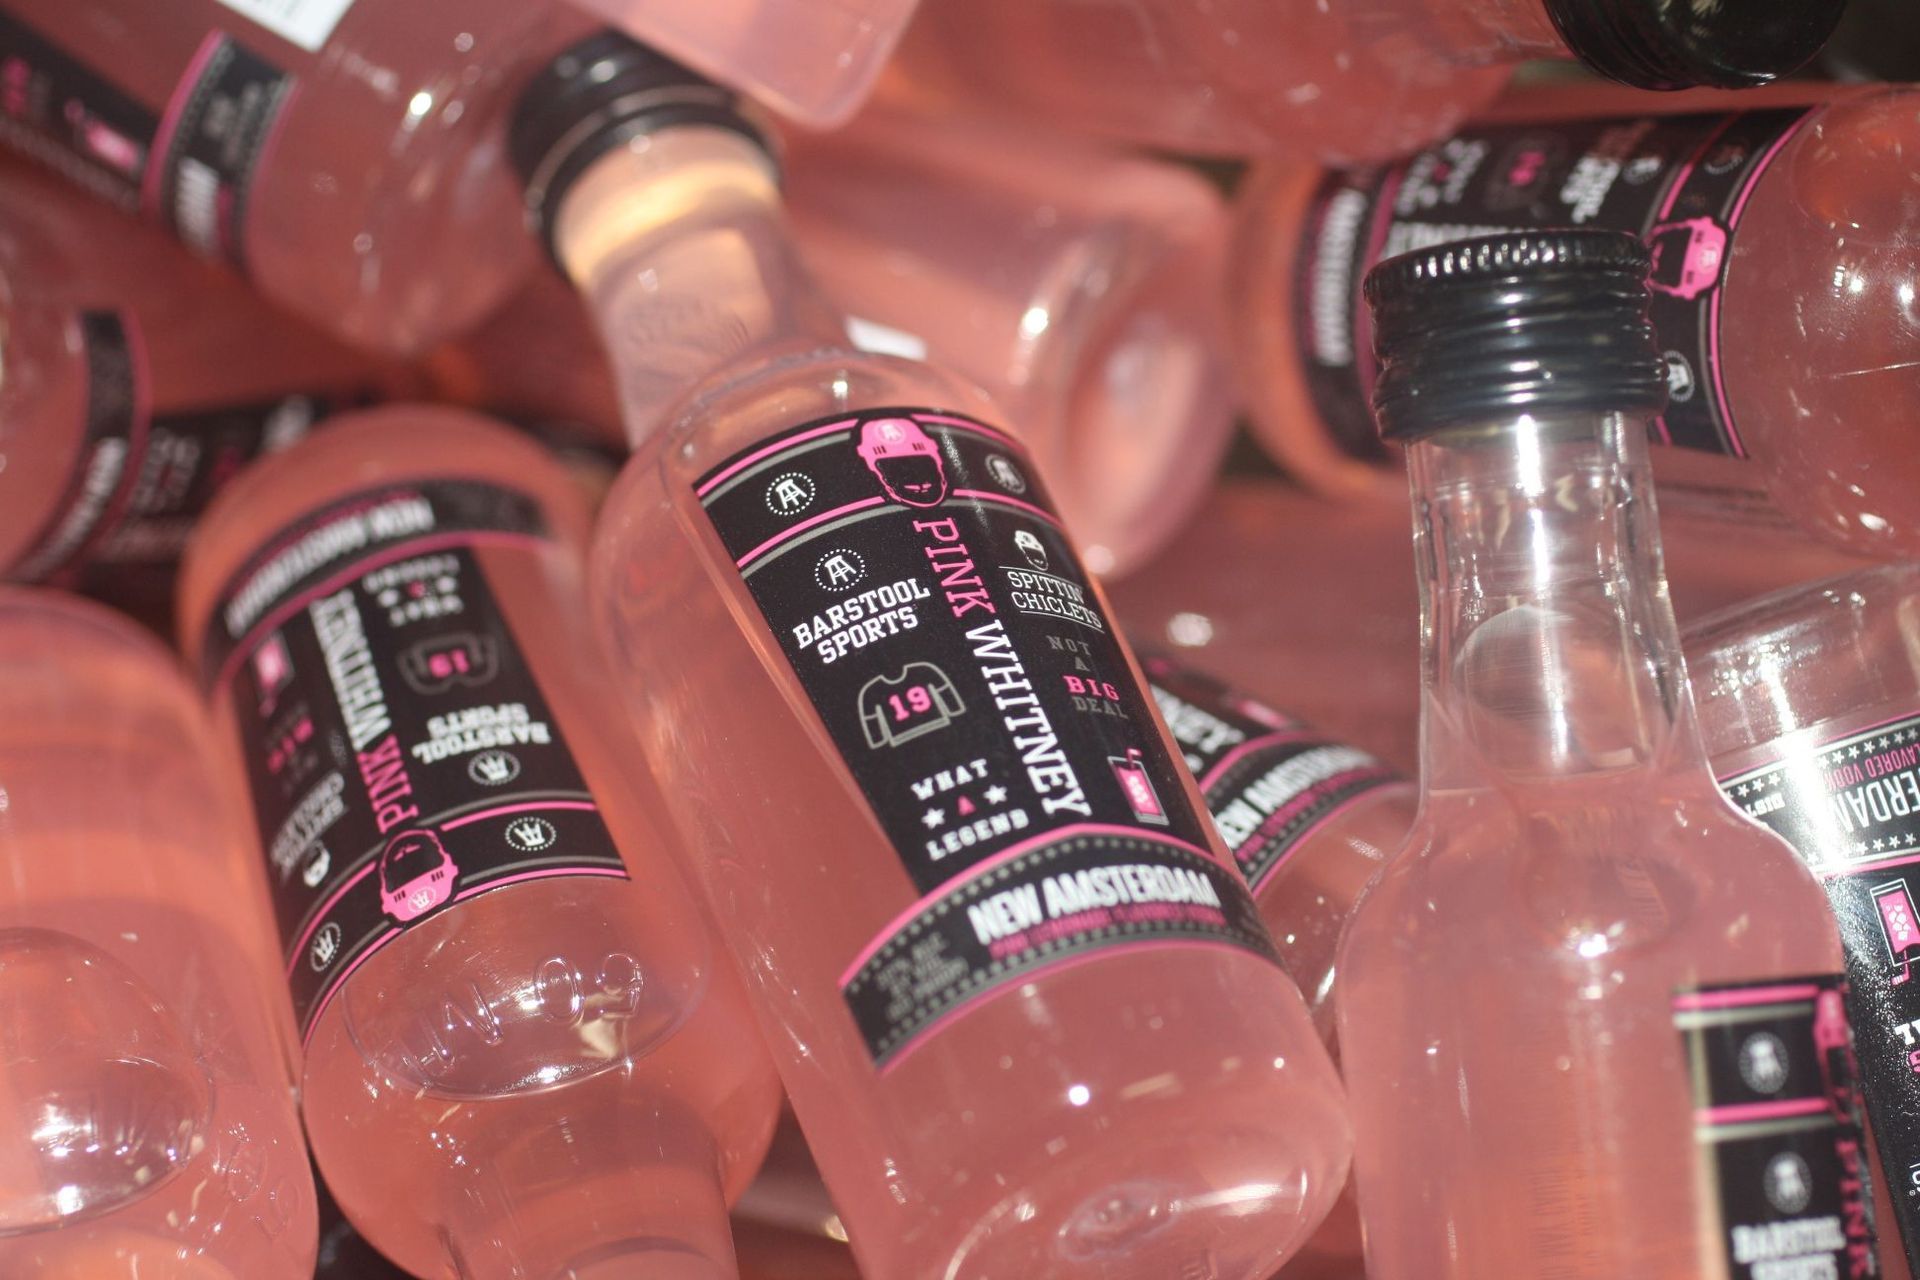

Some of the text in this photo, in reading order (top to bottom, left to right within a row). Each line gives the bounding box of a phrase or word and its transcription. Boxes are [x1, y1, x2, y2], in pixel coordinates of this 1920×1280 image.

[792, 578, 931, 650] BARSTOOL
[1011, 591, 1102, 629] CHICLETS
[817, 606, 919, 664] SPORTS
[1046, 635, 1092, 656] NOT
[308, 588, 394, 751] WHITNEY
[913, 517, 1093, 817] PINK WHITNEY
[1074, 656, 1091, 672] A
[887, 685, 933, 723] 19
[1062, 674, 1120, 701] BIG
[1070, 695, 1129, 720] DEAL
[412, 721, 553, 765] BARSTOOL
[356, 734, 420, 834] PINK
[910, 758, 989, 801] WHAT
[925, 808, 1030, 861] LEGEND
[967, 882, 1043, 947] NEW
[1041, 863, 1222, 919] AMSTERDAM
